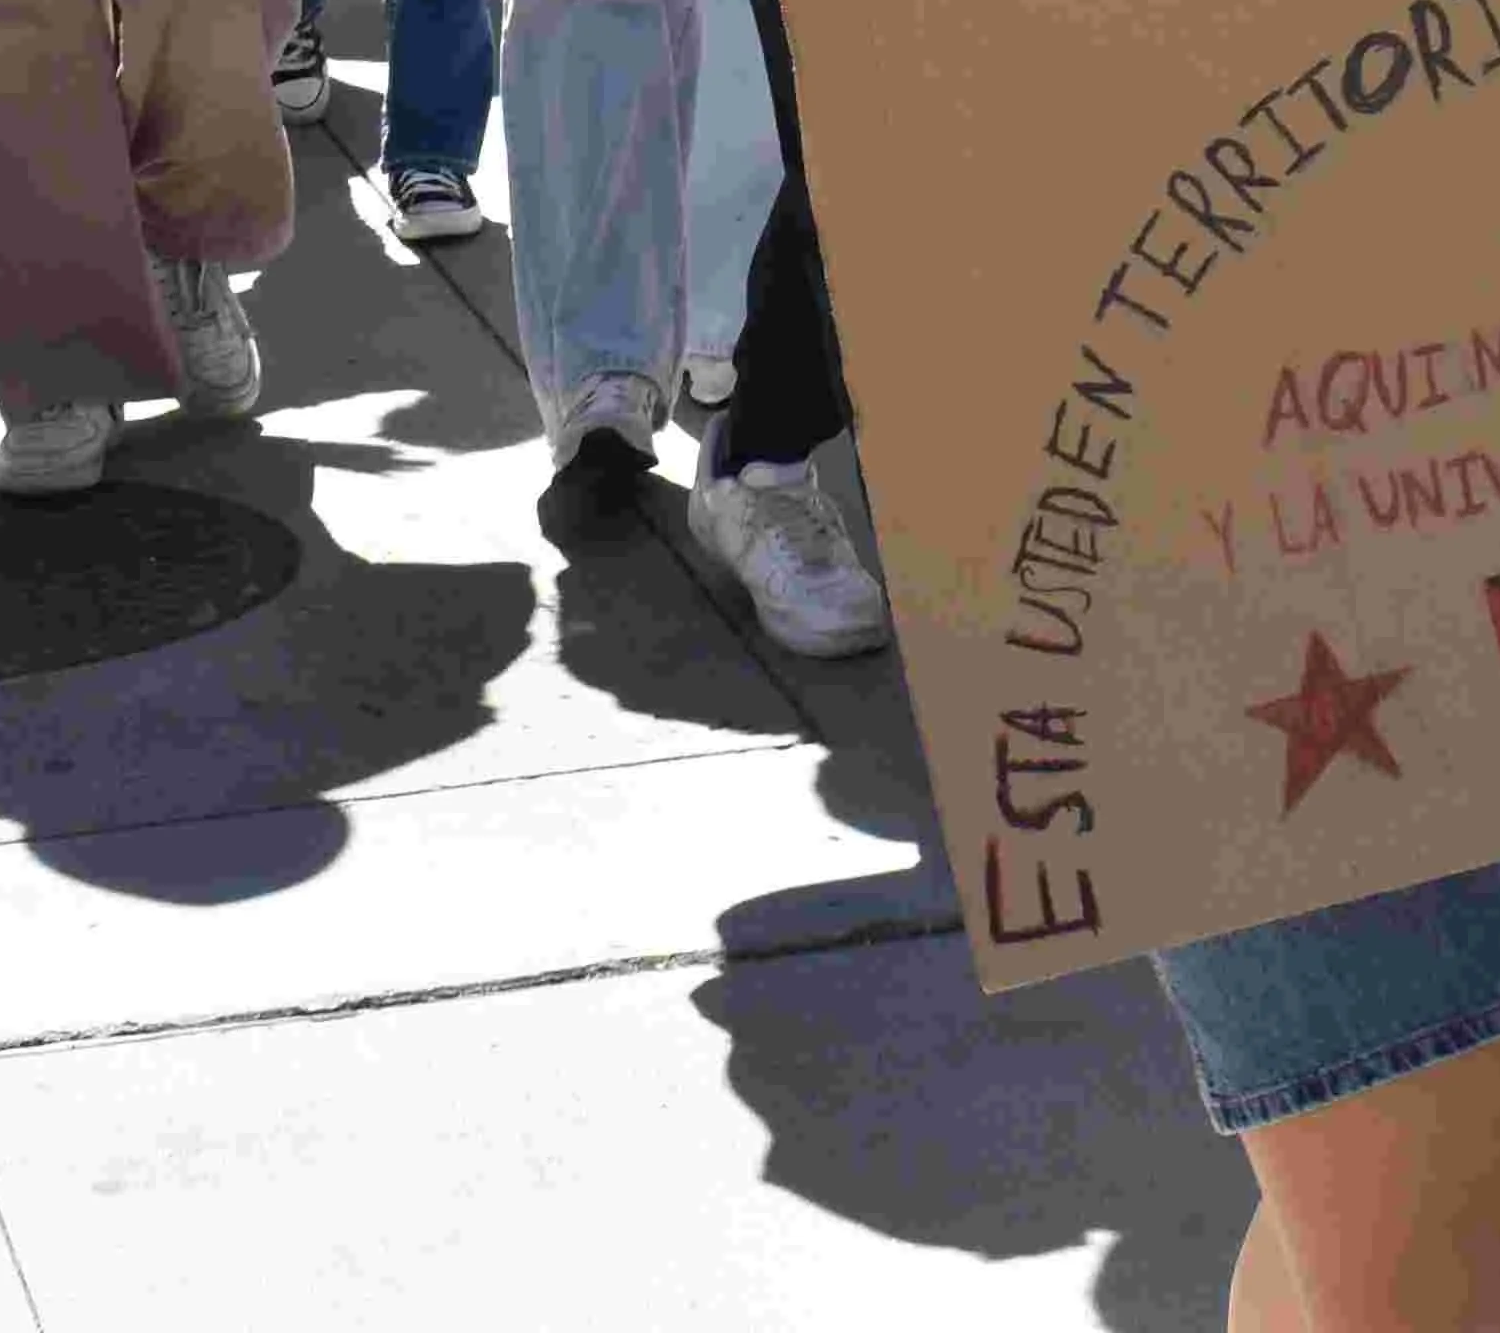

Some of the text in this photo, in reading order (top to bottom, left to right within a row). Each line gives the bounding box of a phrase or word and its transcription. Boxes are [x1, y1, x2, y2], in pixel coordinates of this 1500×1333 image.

[1043, 345, 1134, 478] EN
[1262, 342, 1450, 451] AQUI
[1005, 485, 1119, 656] USTED
[1201, 500, 1237, 575] Y
[1268, 482, 1340, 555] LA
[985, 702, 1102, 944] ESTA
